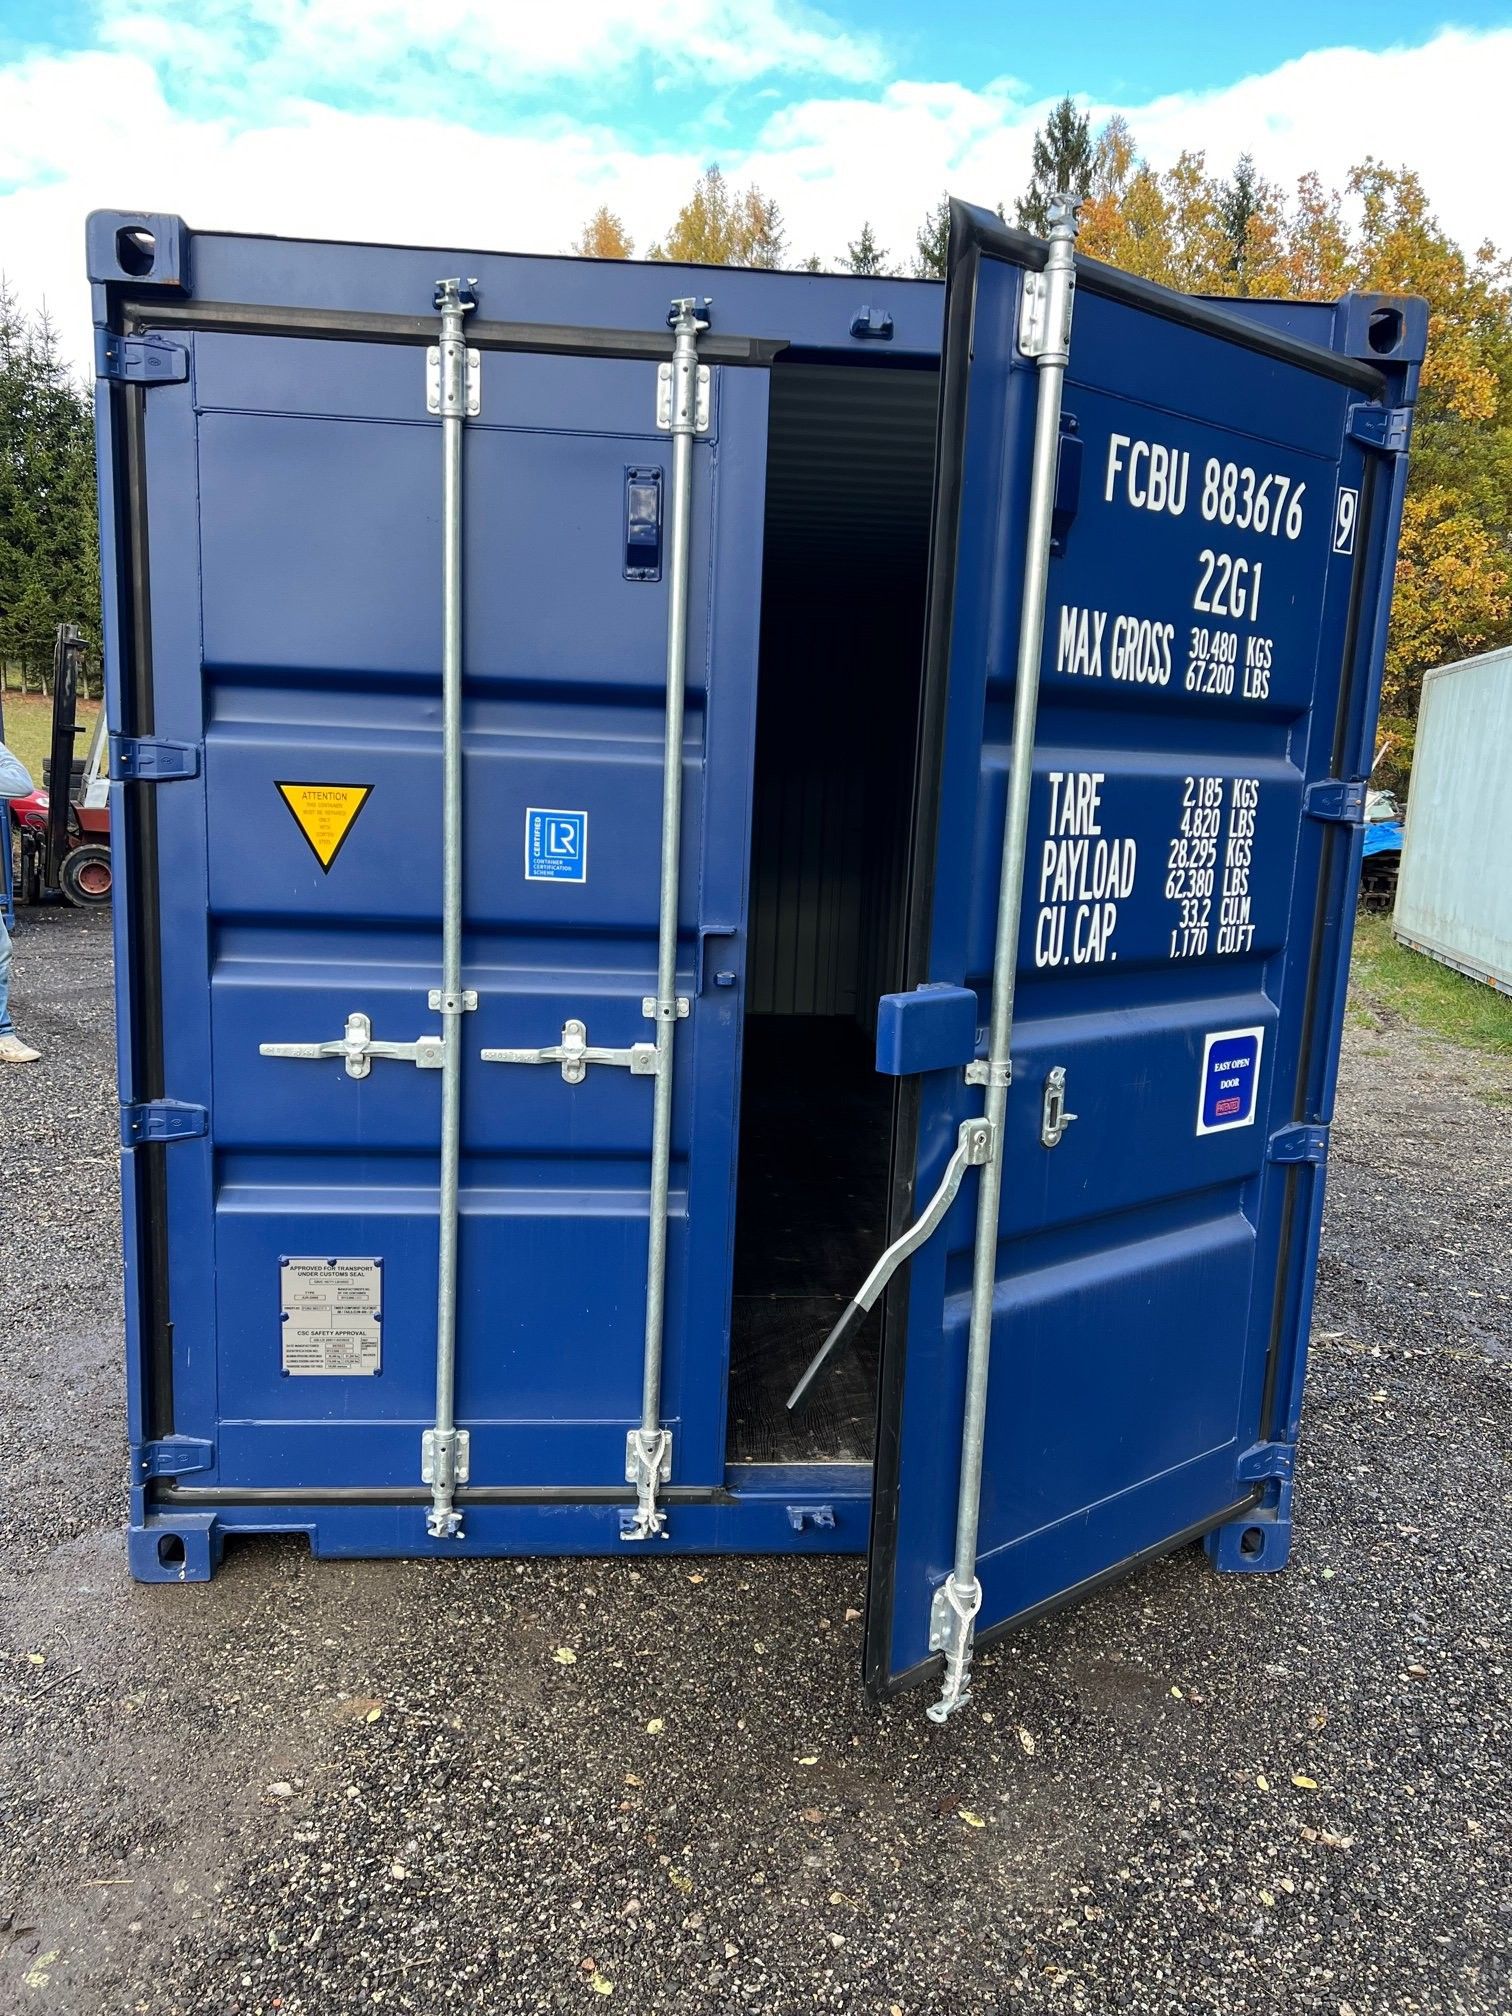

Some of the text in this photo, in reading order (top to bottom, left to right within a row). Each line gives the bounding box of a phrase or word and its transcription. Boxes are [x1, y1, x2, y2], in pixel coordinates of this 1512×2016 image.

[1105, 433, 1355, 549] FCBU 883676 9
[1193, 549, 1263, 622] 22G1
[1057, 605, 1175, 686] MAX GROSS
[1246, 636, 1274, 669] KGS
[1242, 668, 1271, 700] LBS
[302, 791, 348, 801] ATTENTION
[1049, 772, 1105, 836] TARE
[1232, 778, 1260, 808] KGS
[551, 823, 576, 854] LR
[1229, 809, 1257, 838] LBS
[533, 858, 564, 866] CONTAINER
[1225, 838, 1253, 867] KGS
[533, 864, 573, 872] CERTIFICATION
[1039, 838, 1137, 903] PAYLOAD
[1222, 868, 1250, 897] LBS
[1179, 896, 1252, 928] 33.2 CU.M
[1216, 925, 1256, 955] CU.FT
[1214, 1058, 1251, 1072] EASY OPEN
[1220, 1078, 1239, 1090] DOOR
